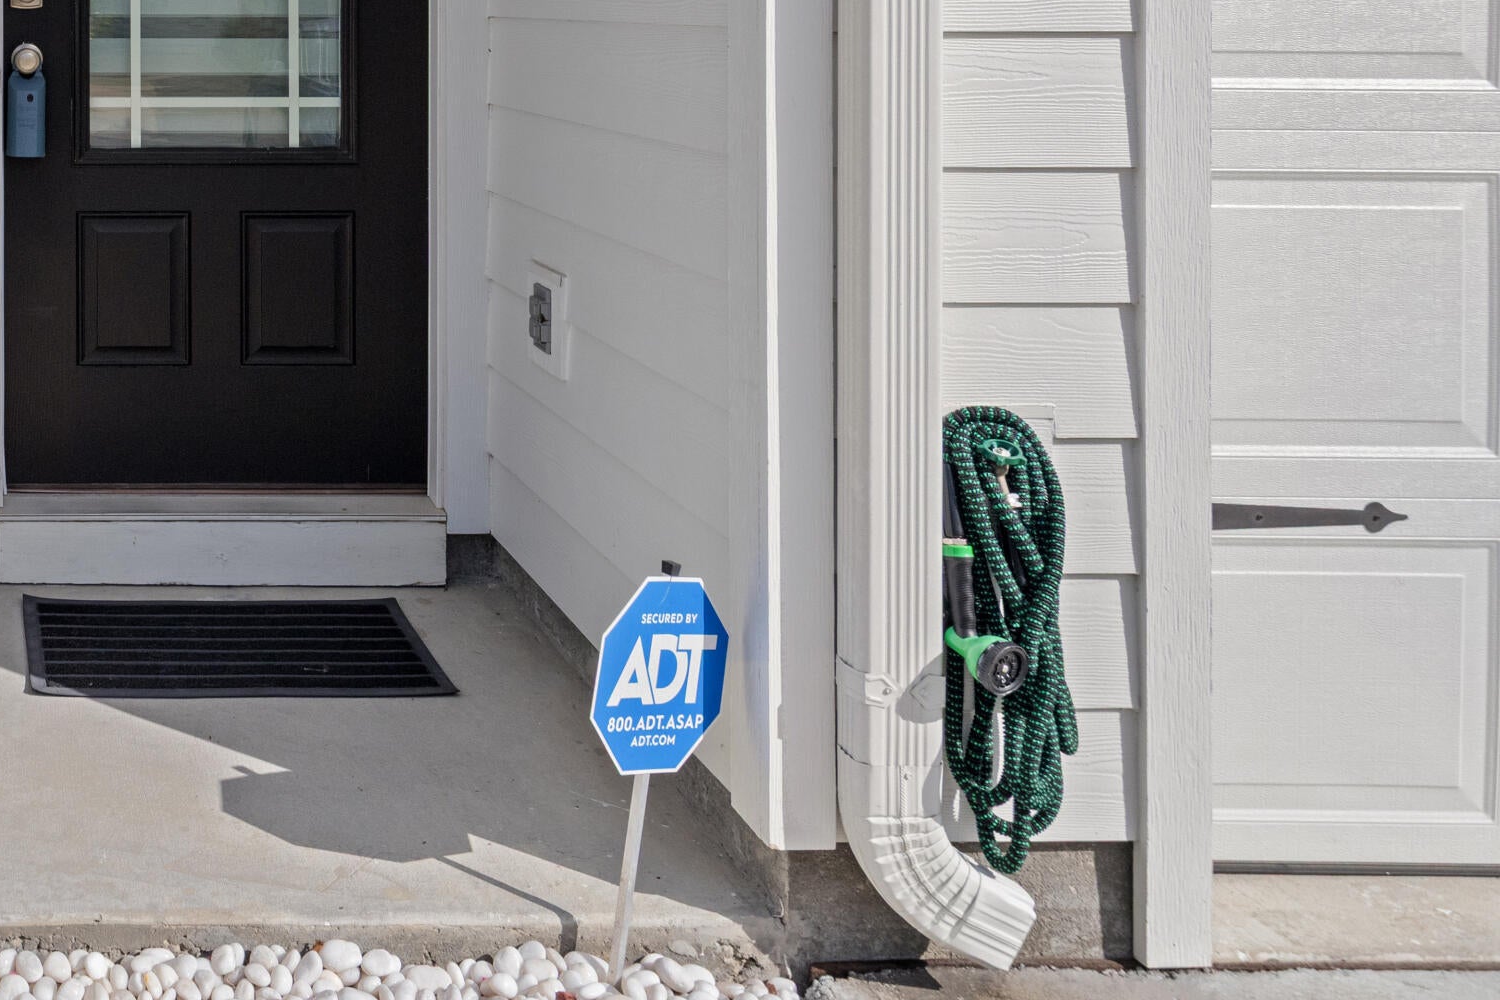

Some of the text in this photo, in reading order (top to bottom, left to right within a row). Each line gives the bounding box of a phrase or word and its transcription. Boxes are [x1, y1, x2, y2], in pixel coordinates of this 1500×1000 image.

[641, 613, 699, 624] SECURED BY
[606, 634, 718, 707] ADT
[607, 714, 704, 732] 800.ADT.ASAP
[630, 734, 676, 747] ADT.COM
